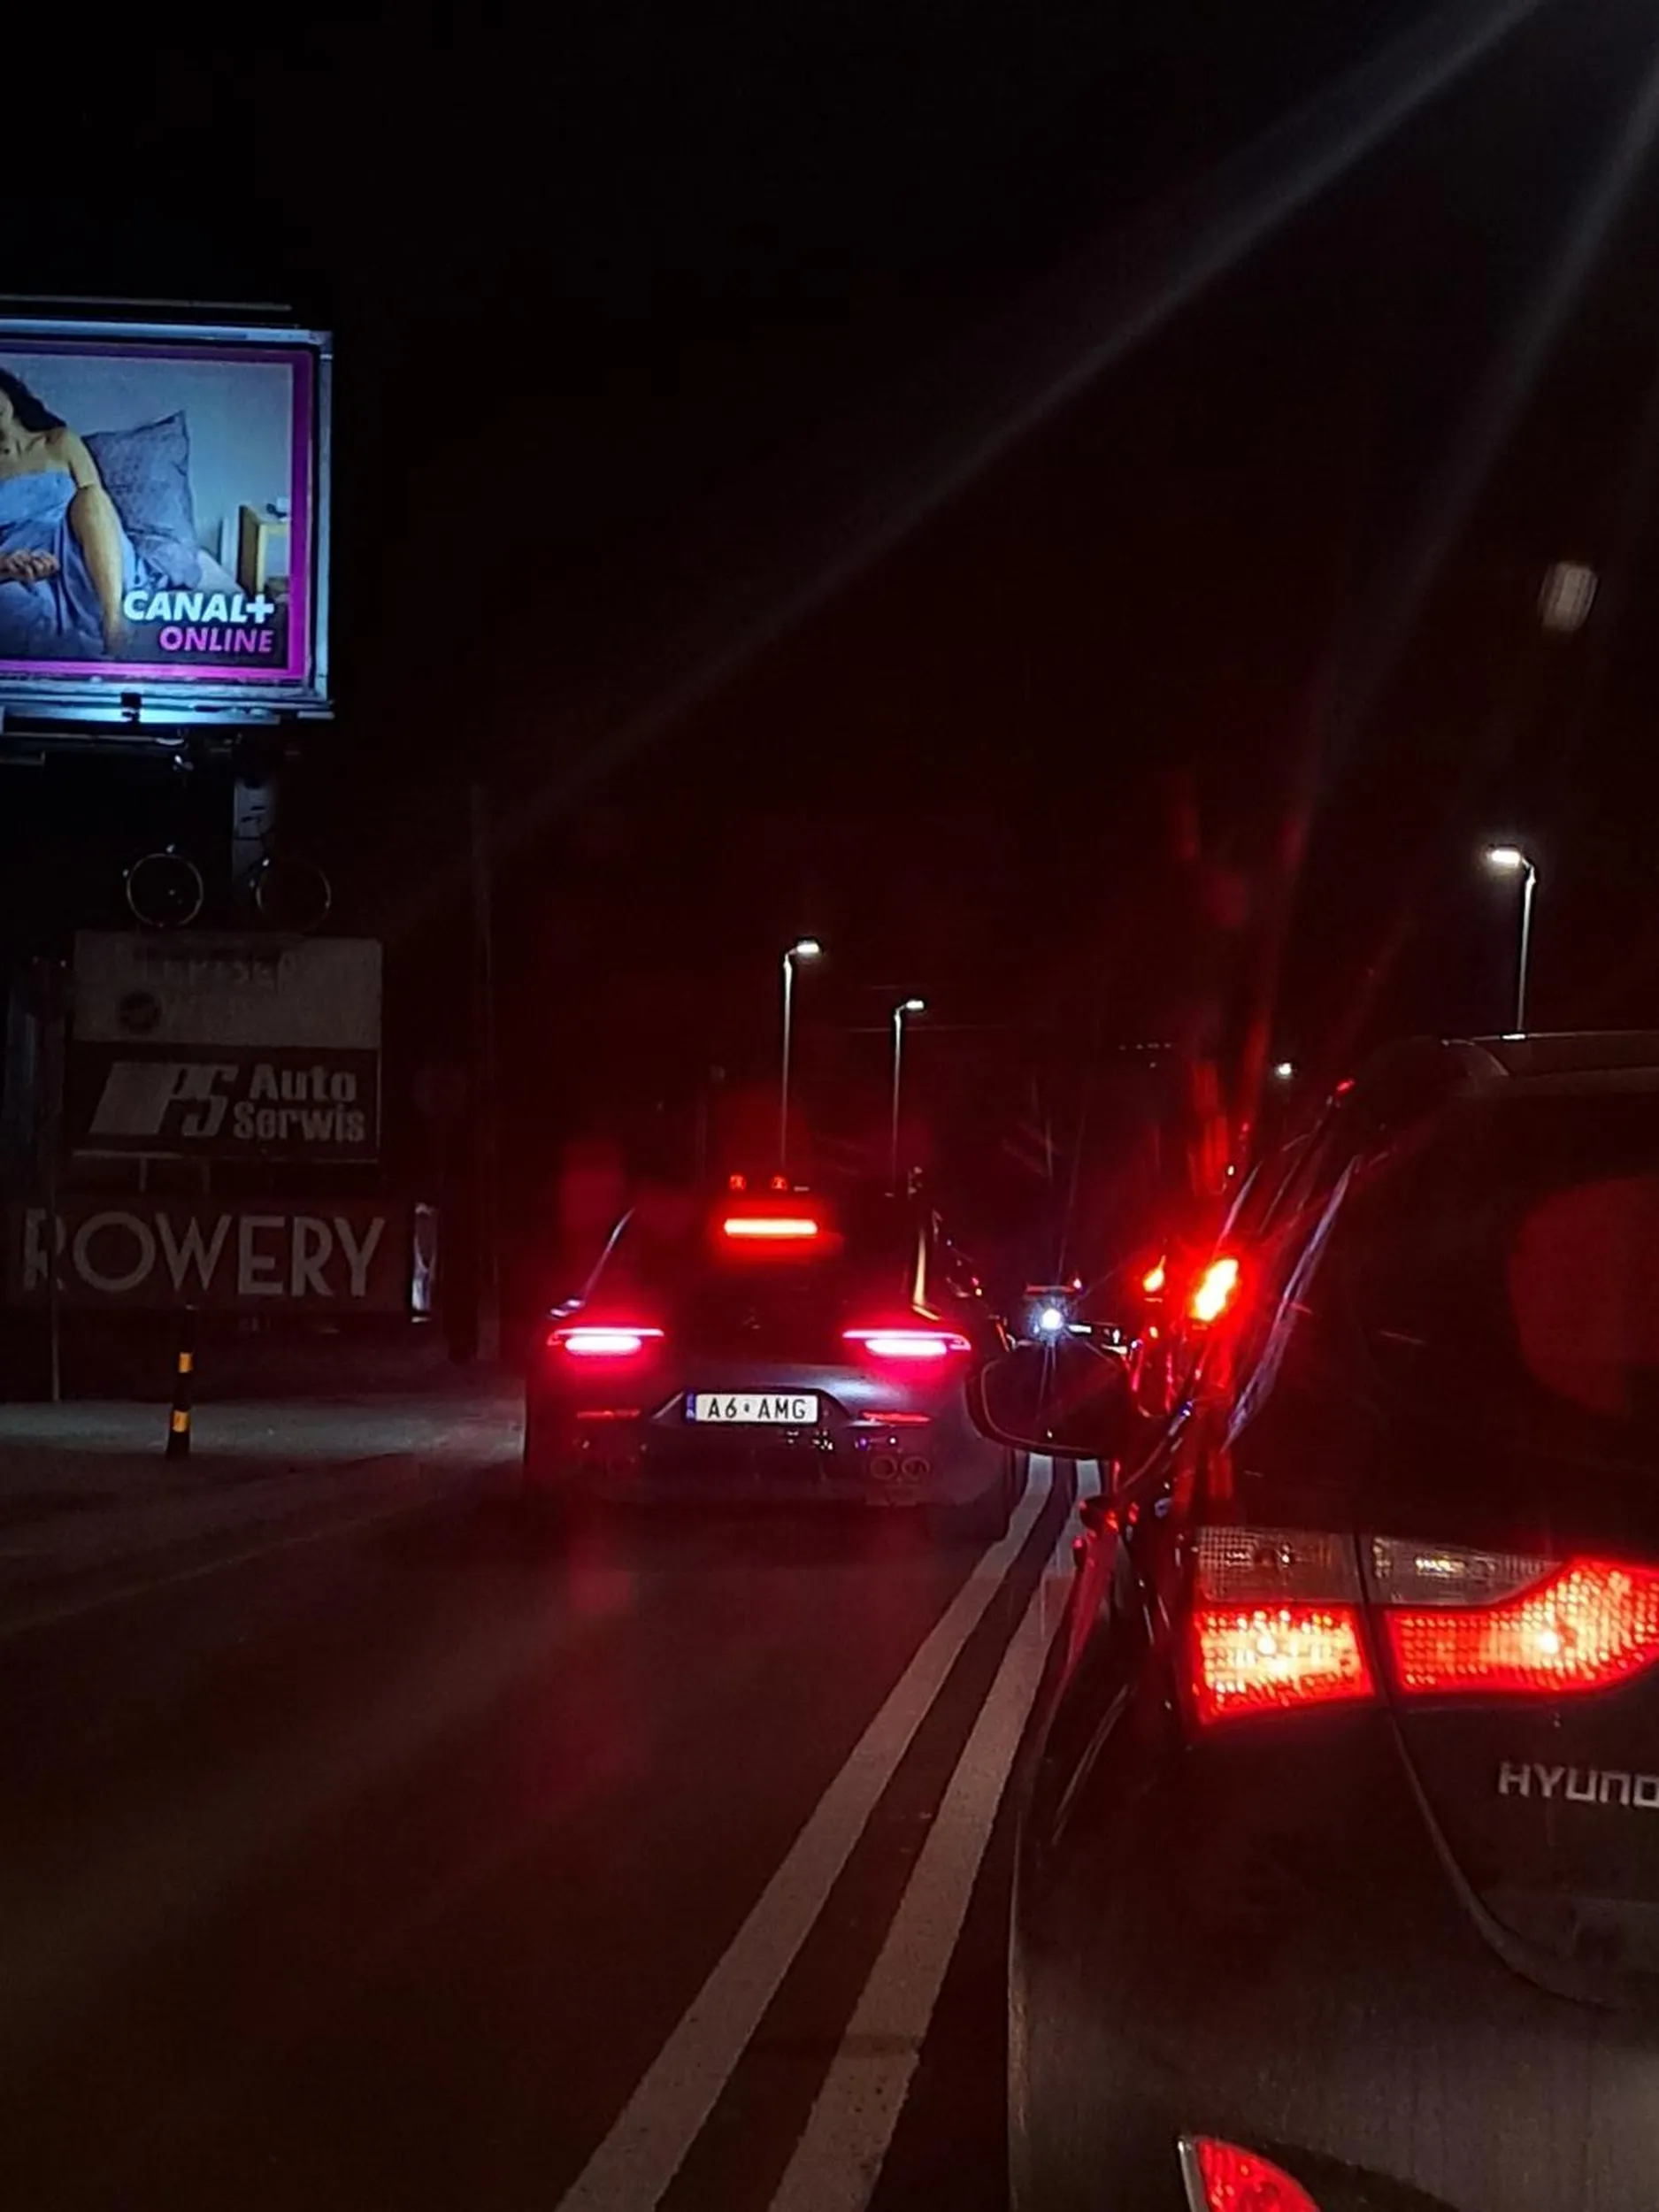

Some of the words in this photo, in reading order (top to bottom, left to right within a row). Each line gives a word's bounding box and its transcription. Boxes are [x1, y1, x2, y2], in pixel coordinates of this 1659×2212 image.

[123, 590, 274, 624] CANAL+
[158, 626, 274, 653] ONLINE
[249, 1063, 357, 1102] Auto
[233, 1101, 366, 1142] Serwis
[22, 1207, 387, 1297] ROWERY
